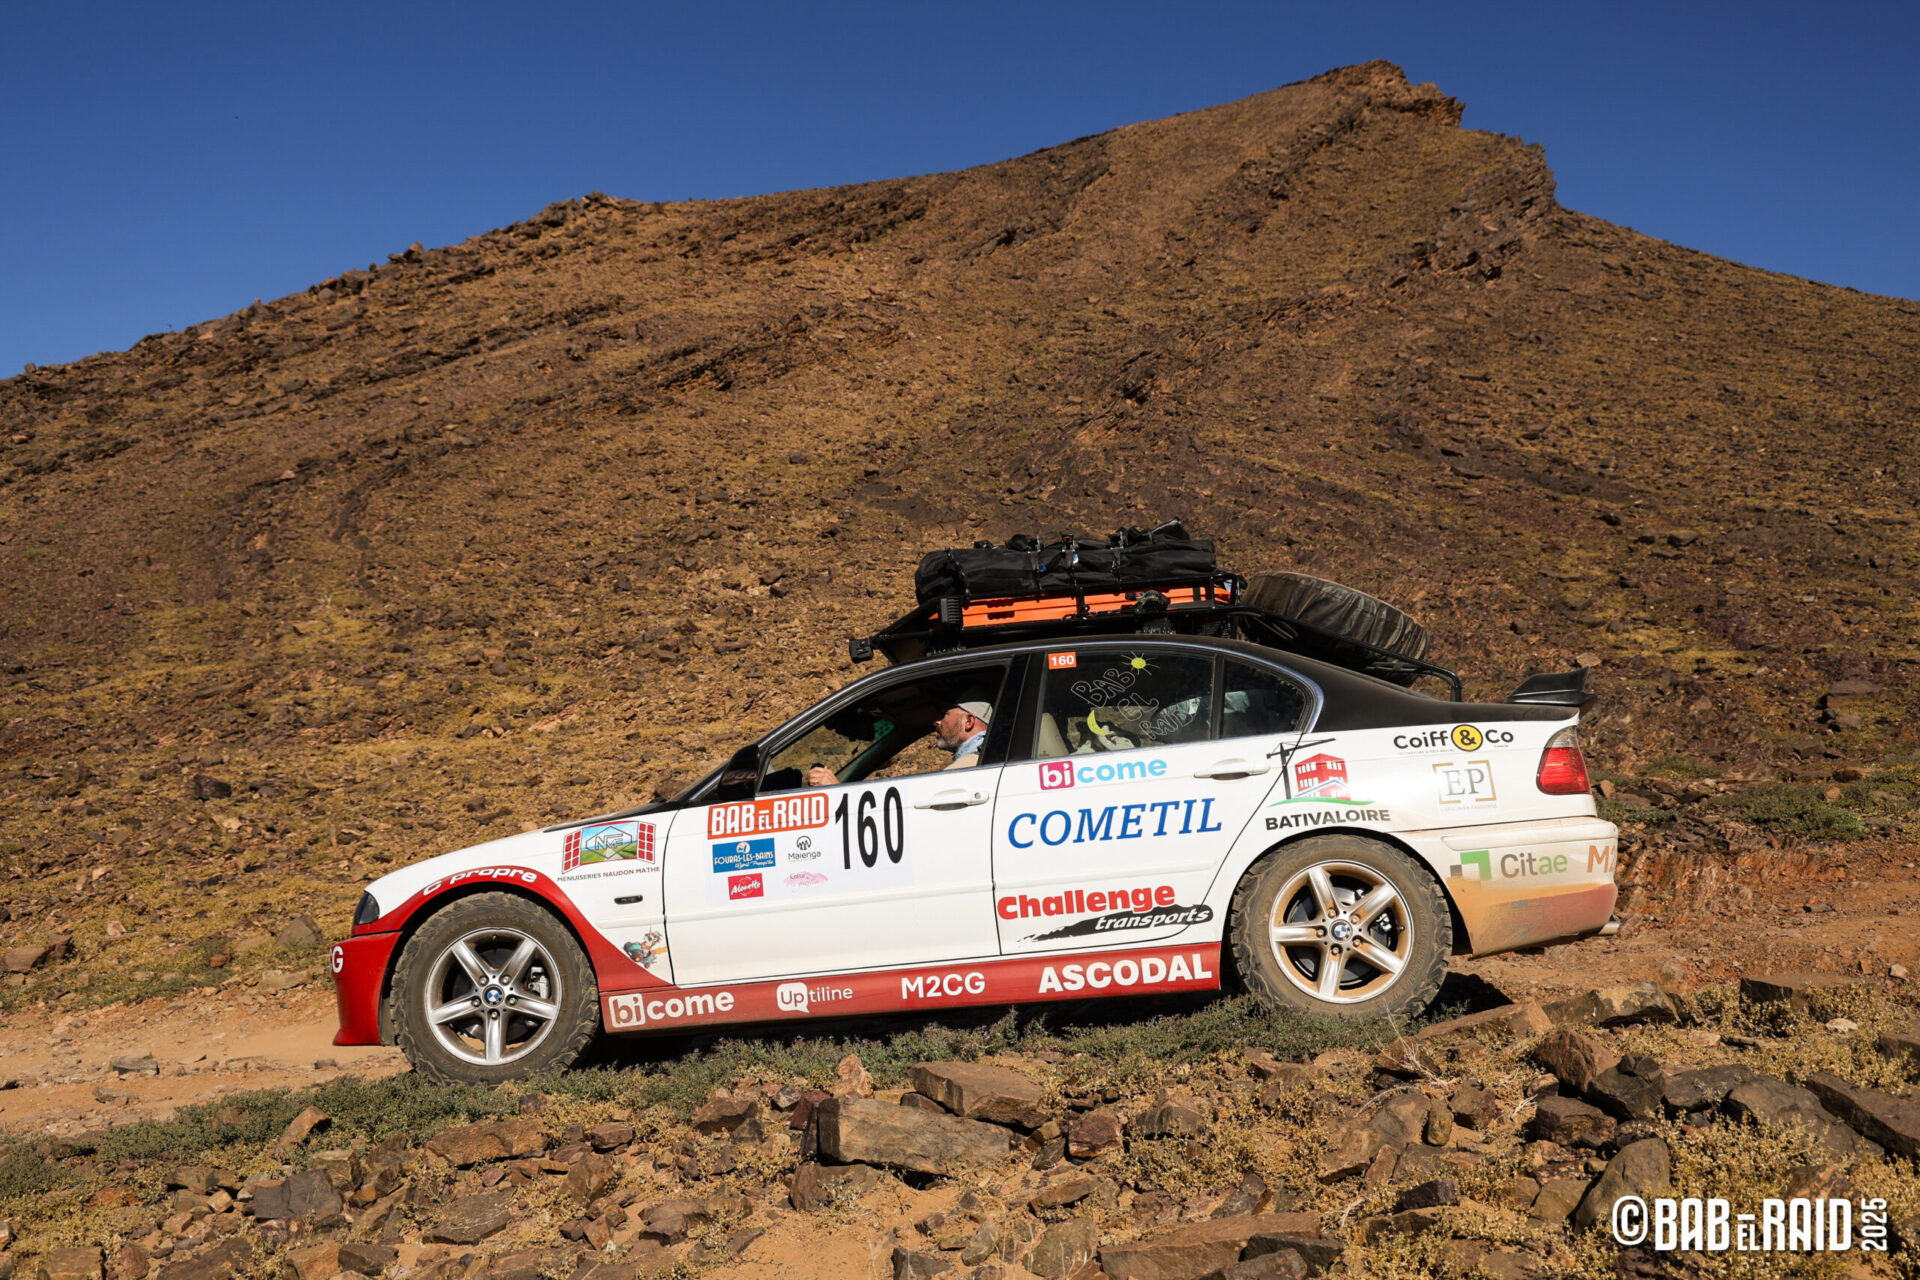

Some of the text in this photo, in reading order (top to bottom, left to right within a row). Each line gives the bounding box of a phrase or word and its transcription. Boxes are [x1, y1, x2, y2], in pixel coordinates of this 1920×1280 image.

[1051, 654, 1075, 666] 160
[1071, 668, 1136, 708] BAB
[1117, 692, 1159, 721] EL
[1393, 728, 1514, 749] Coiff & Co
[1039, 759, 1167, 790] bicome
[1442, 768, 1485, 796] EP
[711, 795, 827, 836] BAB EL RAID
[835, 786, 904, 869] 160
[1008, 798, 1222, 849] COMETIL
[1265, 809, 1391, 831] BATIVALOIRE
[449, 868, 538, 883] propre
[557, 872, 601, 882] MENUISERIES
[602, 869, 634, 878] NAUDON
[1500, 852, 1568, 878] Citae
[731, 880, 761, 895] Alouette
[997, 885, 1175, 920] Challenge
[1095, 906, 1211, 931] transports
[901, 972, 986, 1000] M2CG
[1038, 953, 1213, 994] ASCODAL
[608, 992, 734, 1028] bicome
